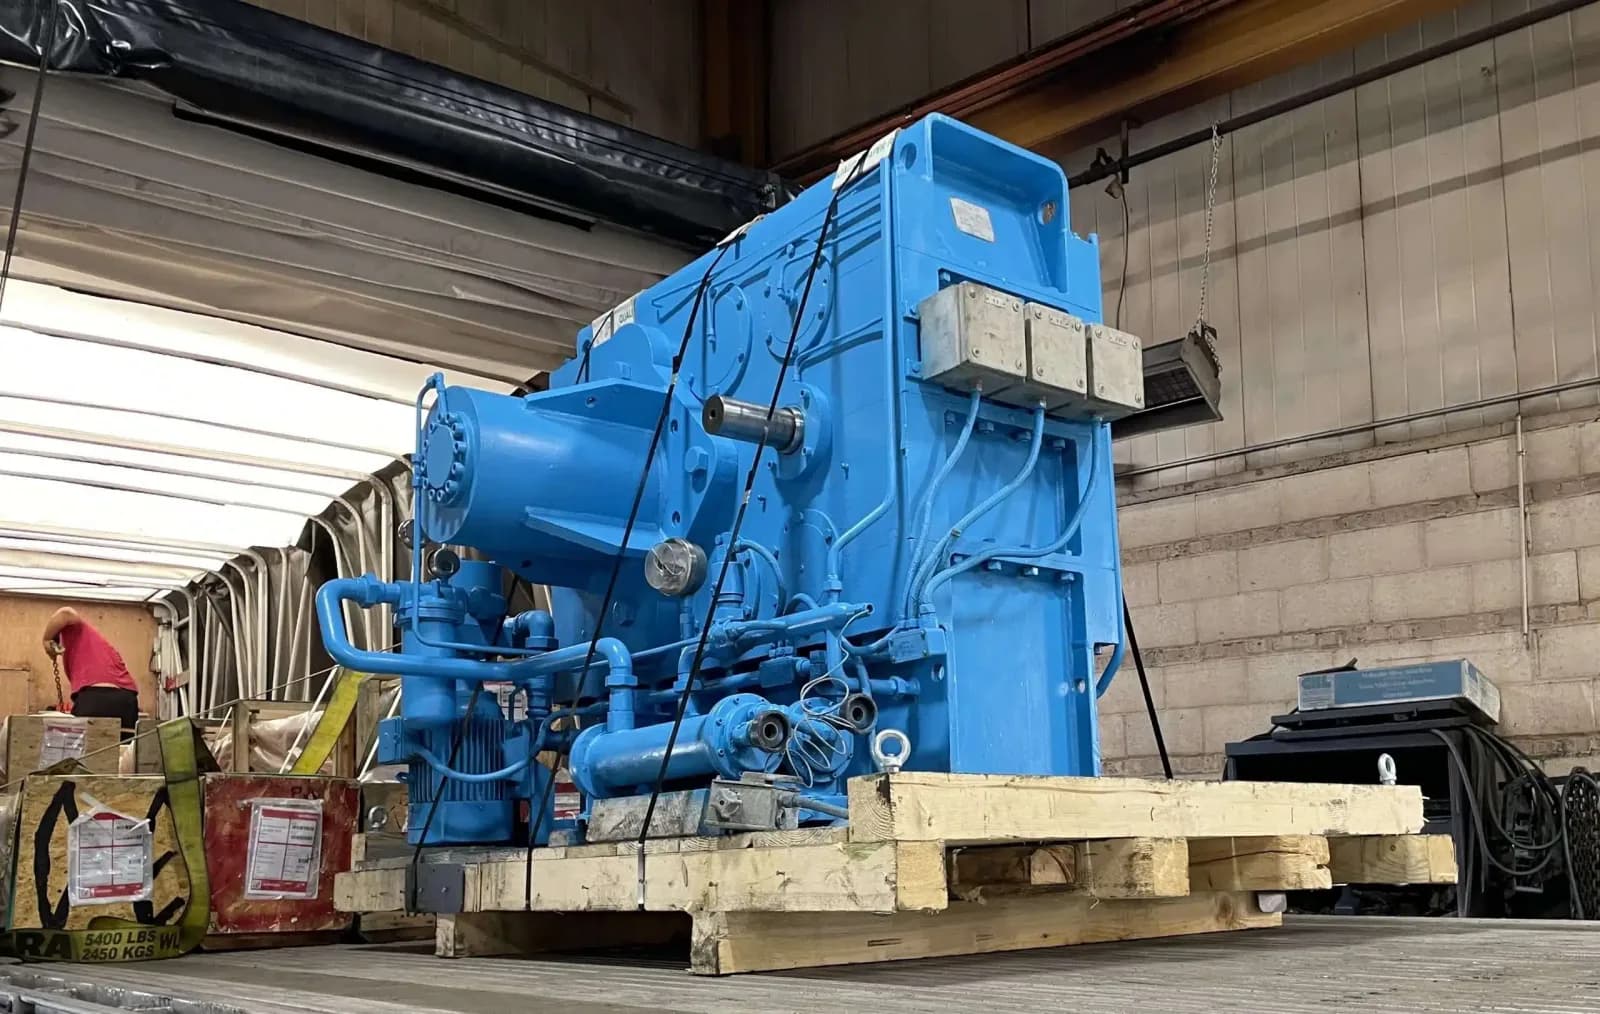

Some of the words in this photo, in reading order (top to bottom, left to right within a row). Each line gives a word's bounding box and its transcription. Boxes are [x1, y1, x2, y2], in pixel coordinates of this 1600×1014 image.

[85, 932, 122, 946] 5400
[126, 930, 156, 944] LBS
[81, 947, 118, 961] 2450
[122, 945, 154, 959] KGS
